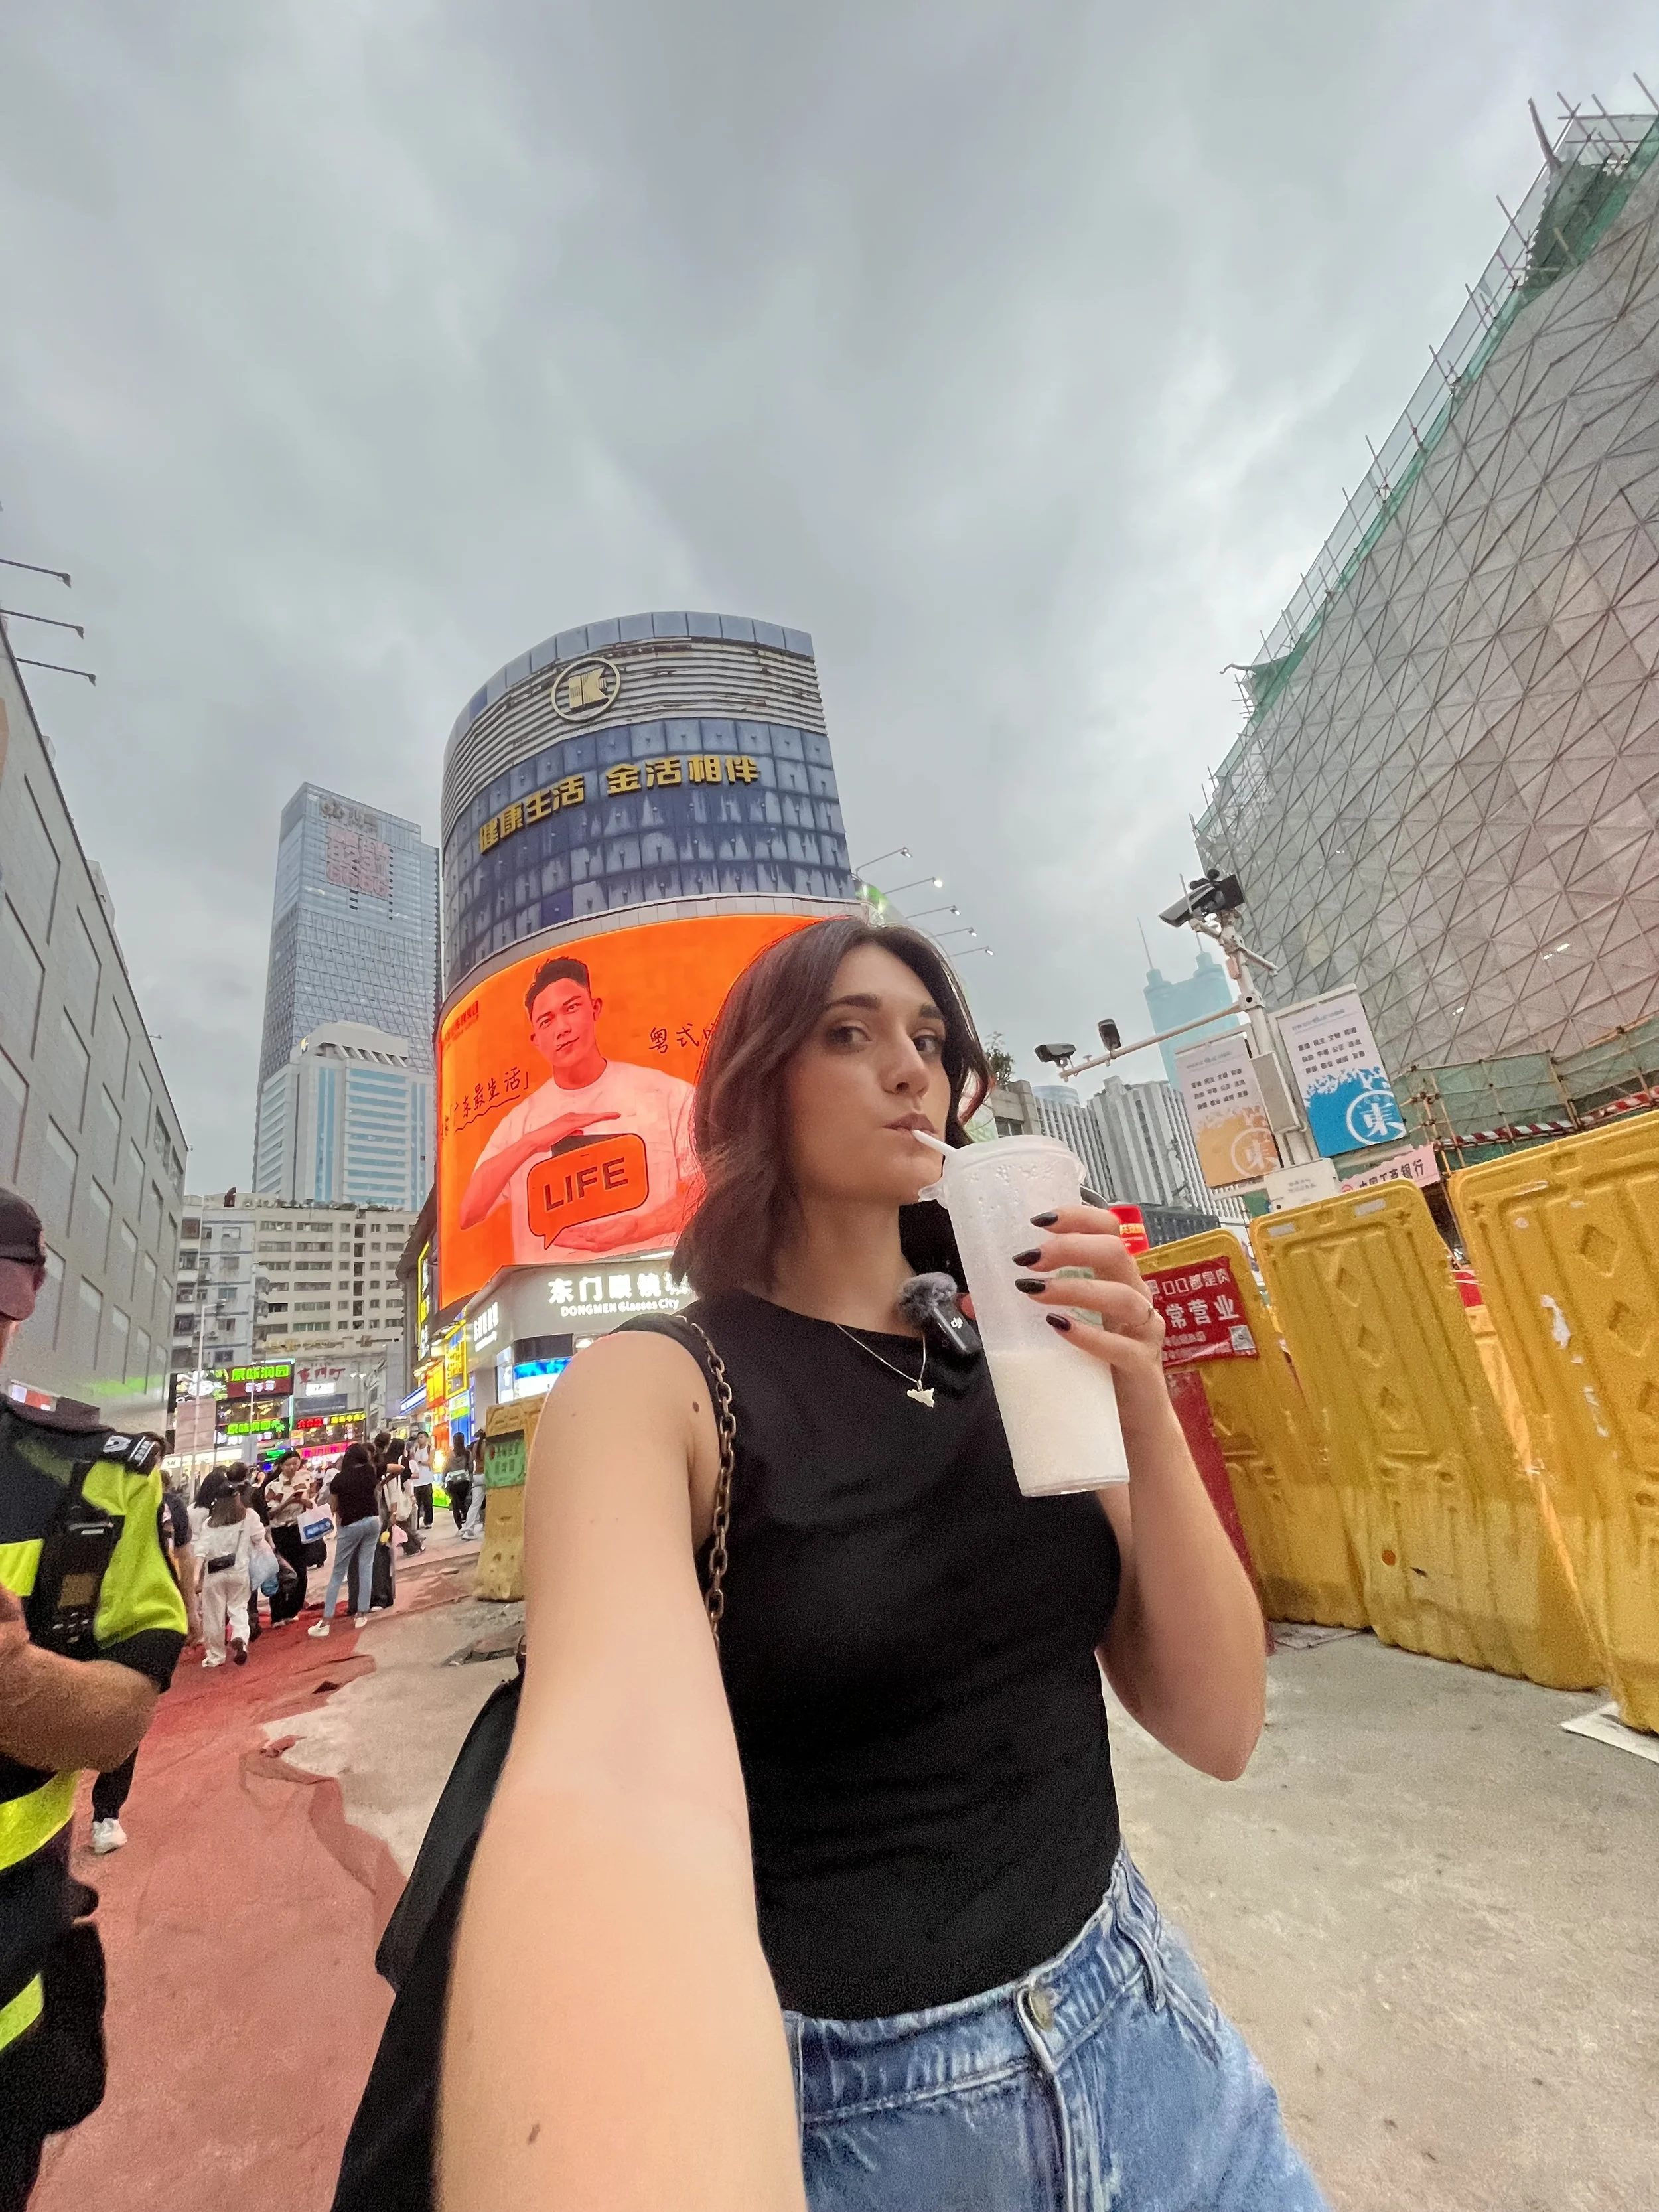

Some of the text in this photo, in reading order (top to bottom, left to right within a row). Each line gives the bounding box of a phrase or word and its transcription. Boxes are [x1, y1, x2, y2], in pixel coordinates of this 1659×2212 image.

[479, 754, 760, 854] 健康生活 金活相伴
[545, 1157, 628, 1212] LIFE
[561, 1297, 680, 1317] DONGMEN Glasses City
